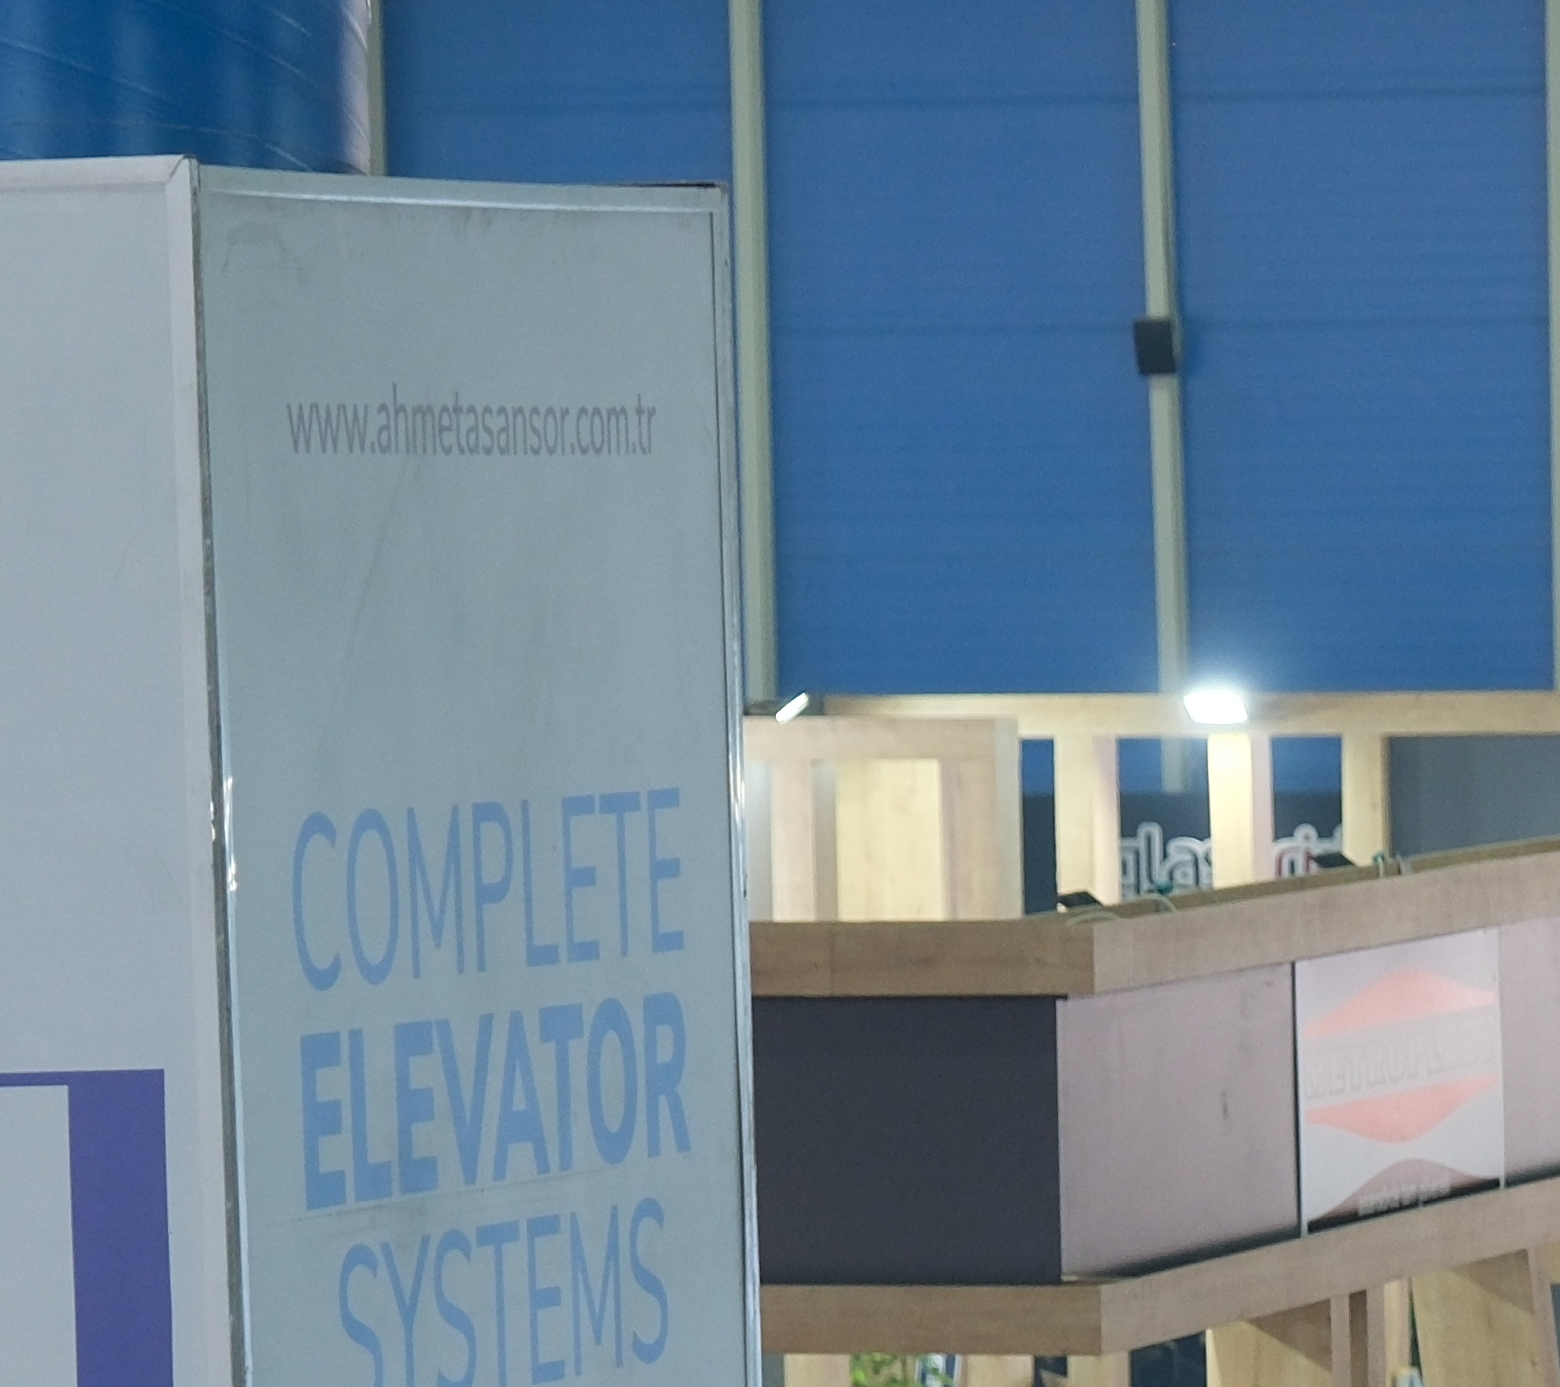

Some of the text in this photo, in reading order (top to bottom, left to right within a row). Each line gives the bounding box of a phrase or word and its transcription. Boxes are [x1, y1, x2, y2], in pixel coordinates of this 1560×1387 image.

[287, 383, 657, 456] www.ahmetasansor.com.tr
[293, 787, 685, 991] COMPLETE
[300, 992, 691, 1210] ELEVATOR
